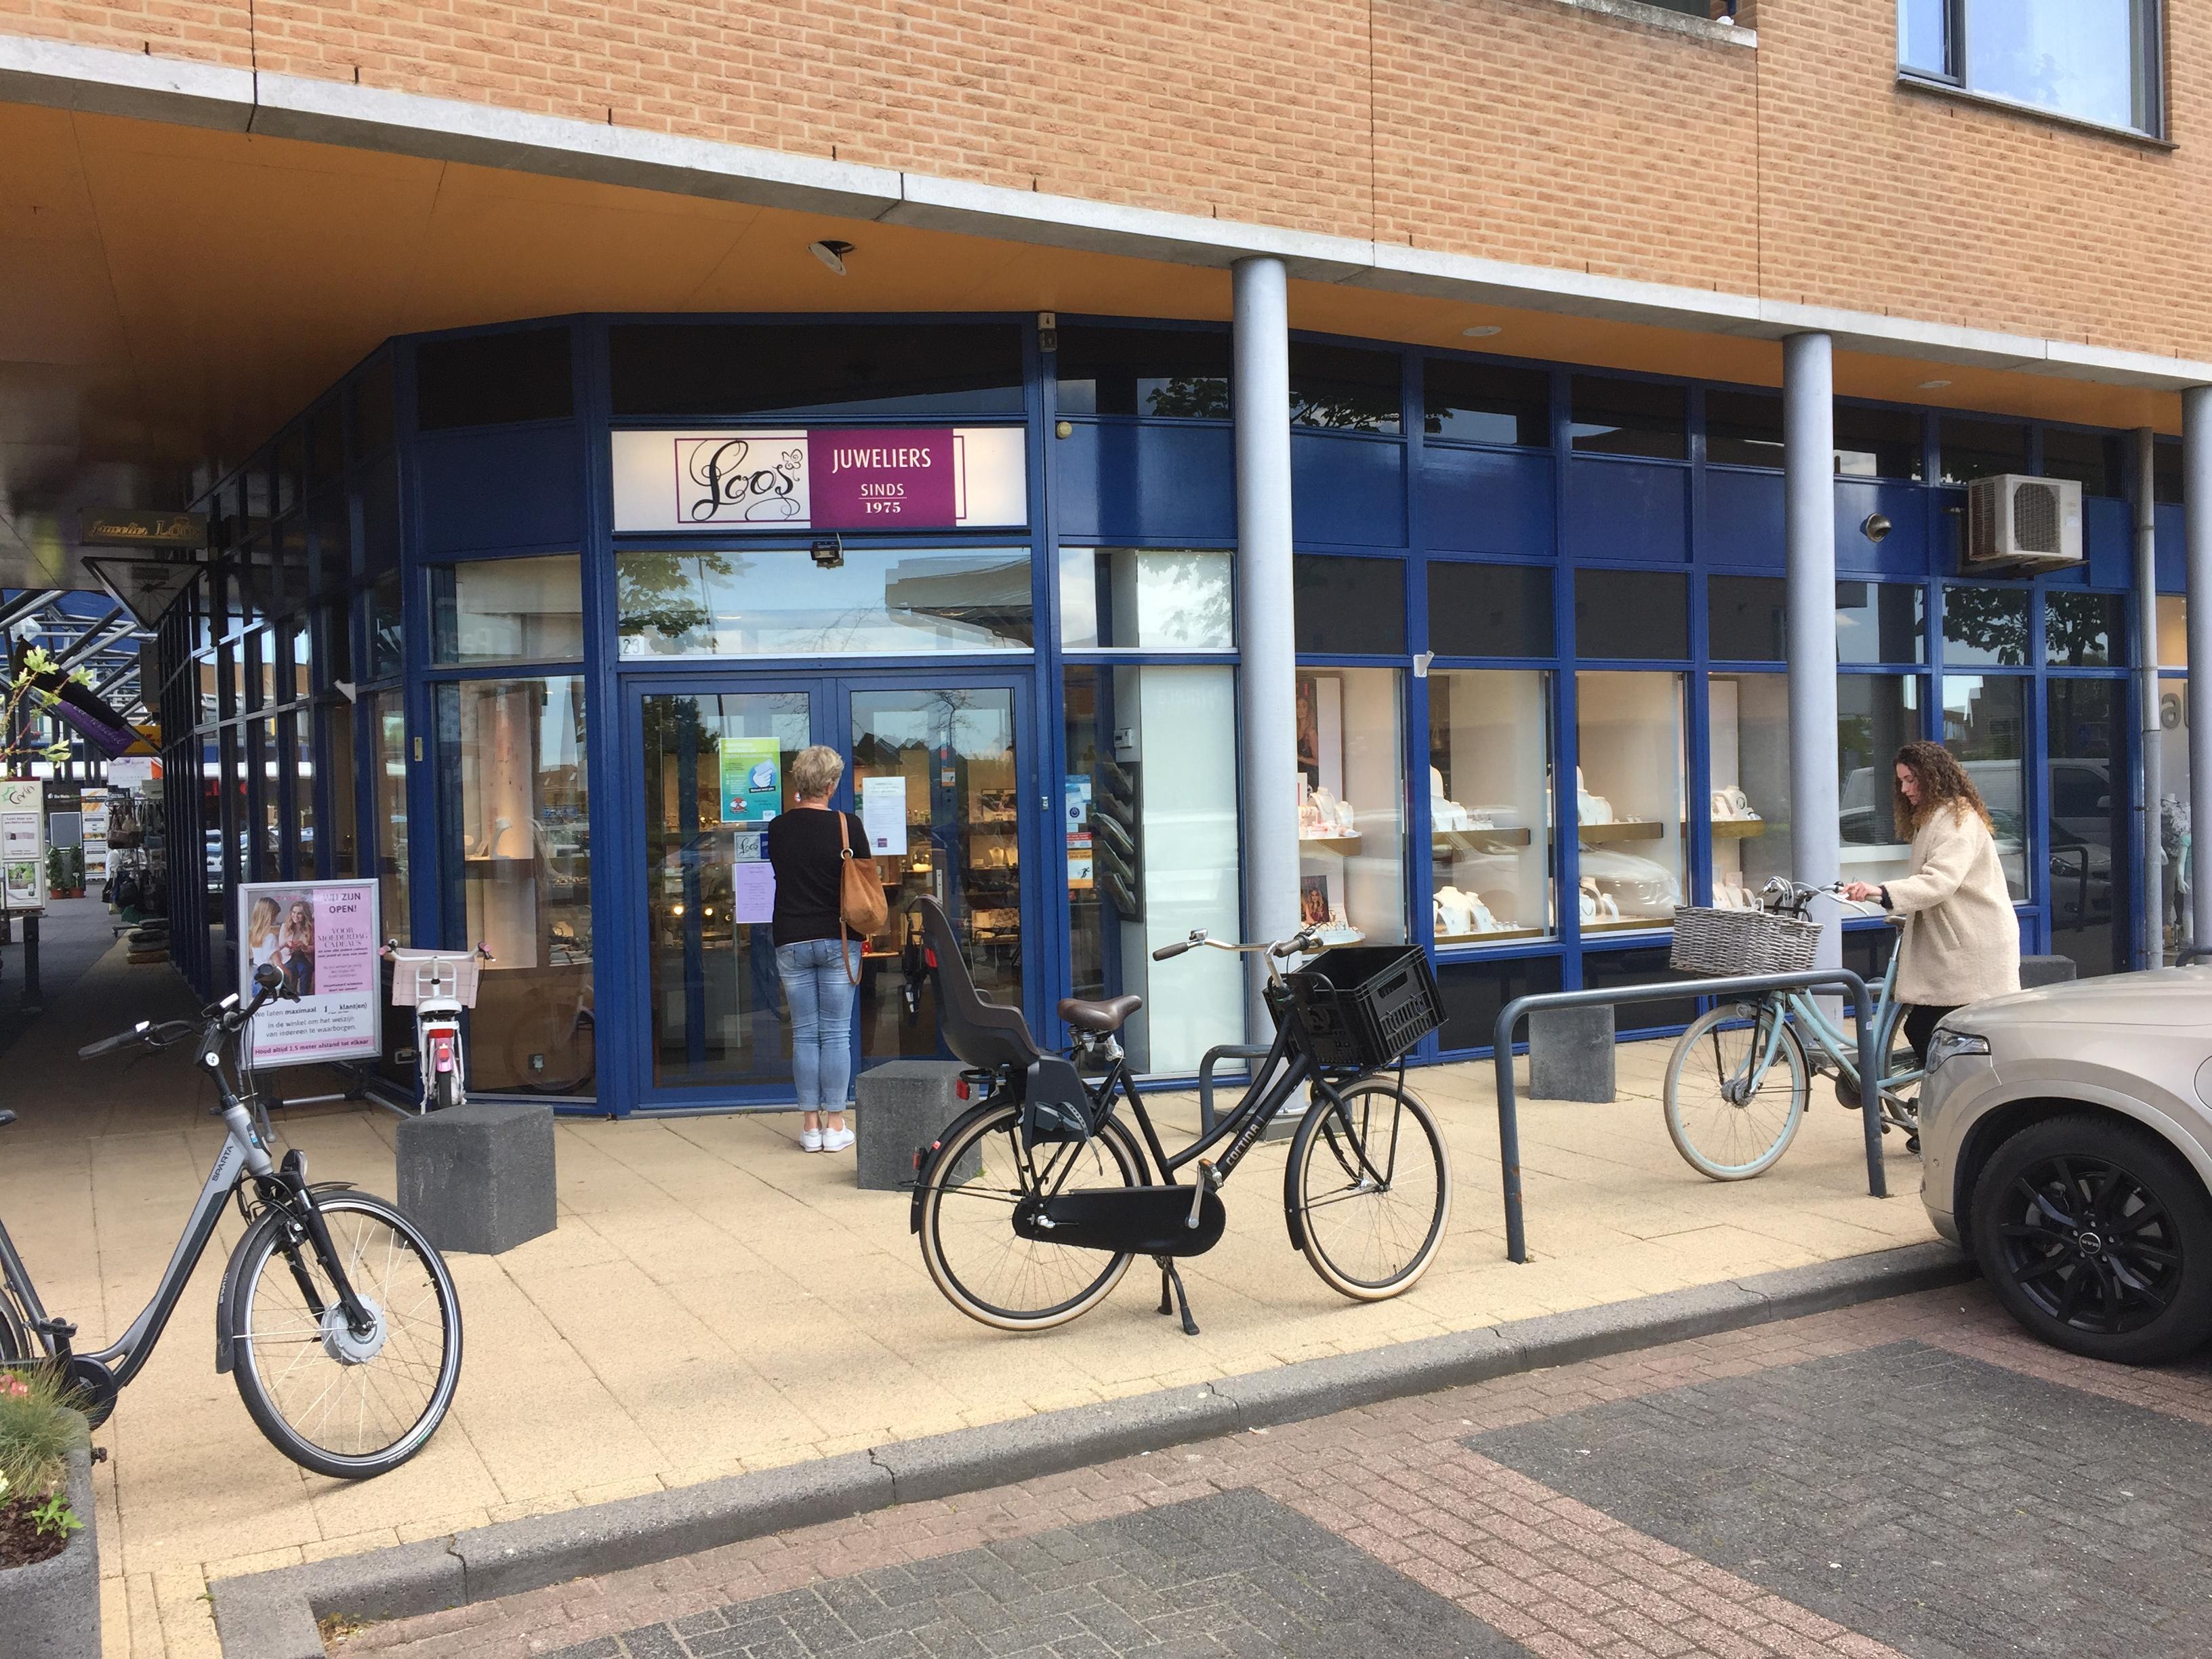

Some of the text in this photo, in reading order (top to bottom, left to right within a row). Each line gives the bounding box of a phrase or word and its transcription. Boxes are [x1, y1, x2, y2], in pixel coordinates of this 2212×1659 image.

[832, 448, 932, 474] JUWELIERS
[690, 439, 800, 520] Loos
[861, 483, 905, 497] SINDS
[865, 501, 901, 514] 1975
[341, 892, 361, 901] ZIJN
[329, 905, 357, 914] OPEN!
[285, 1006, 316, 1015] maximaal
[211, 1145, 234, 1182] SPARTA
